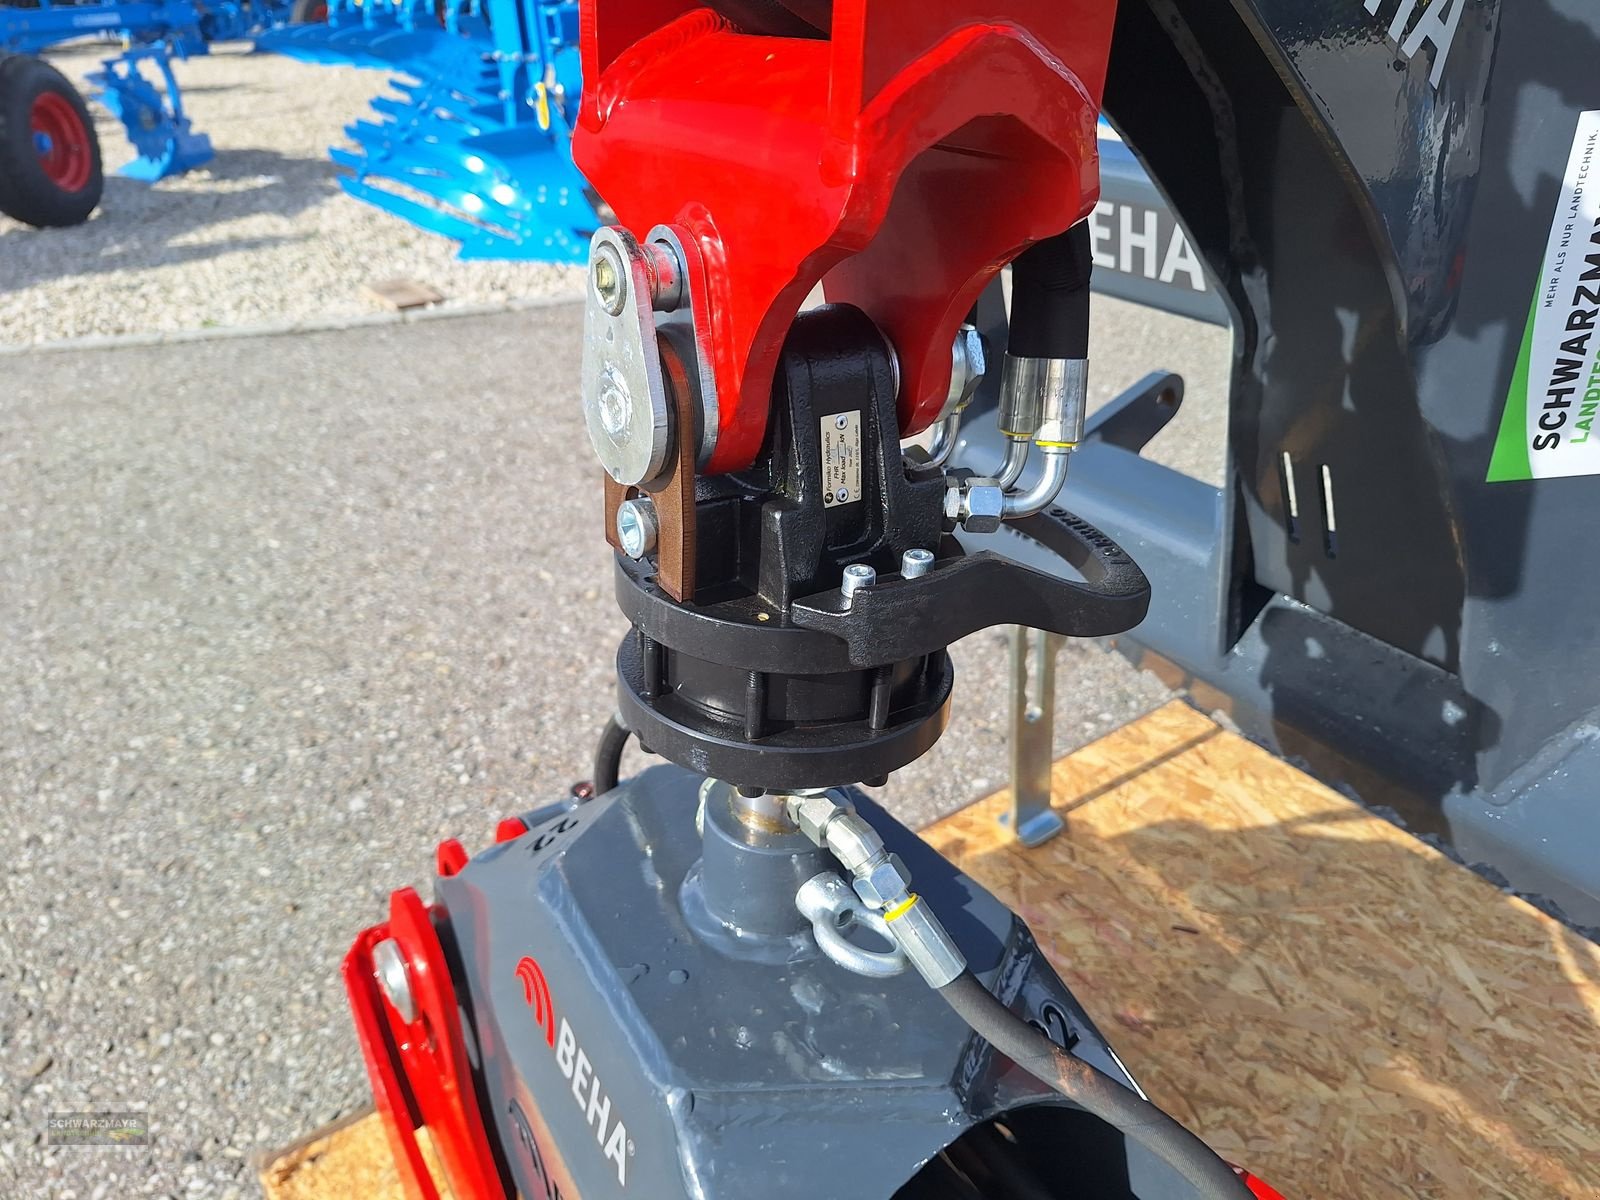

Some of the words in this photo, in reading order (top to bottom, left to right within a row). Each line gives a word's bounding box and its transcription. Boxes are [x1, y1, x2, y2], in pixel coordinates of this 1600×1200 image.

[1532, 203, 1600, 450] SCHWARZM
[1544, 277, 1560, 307] MEHR
[1554, 251, 1566, 273] ALS
[1560, 223, 1574, 247] NUR
[555, 1016, 627, 1187] BEHA
